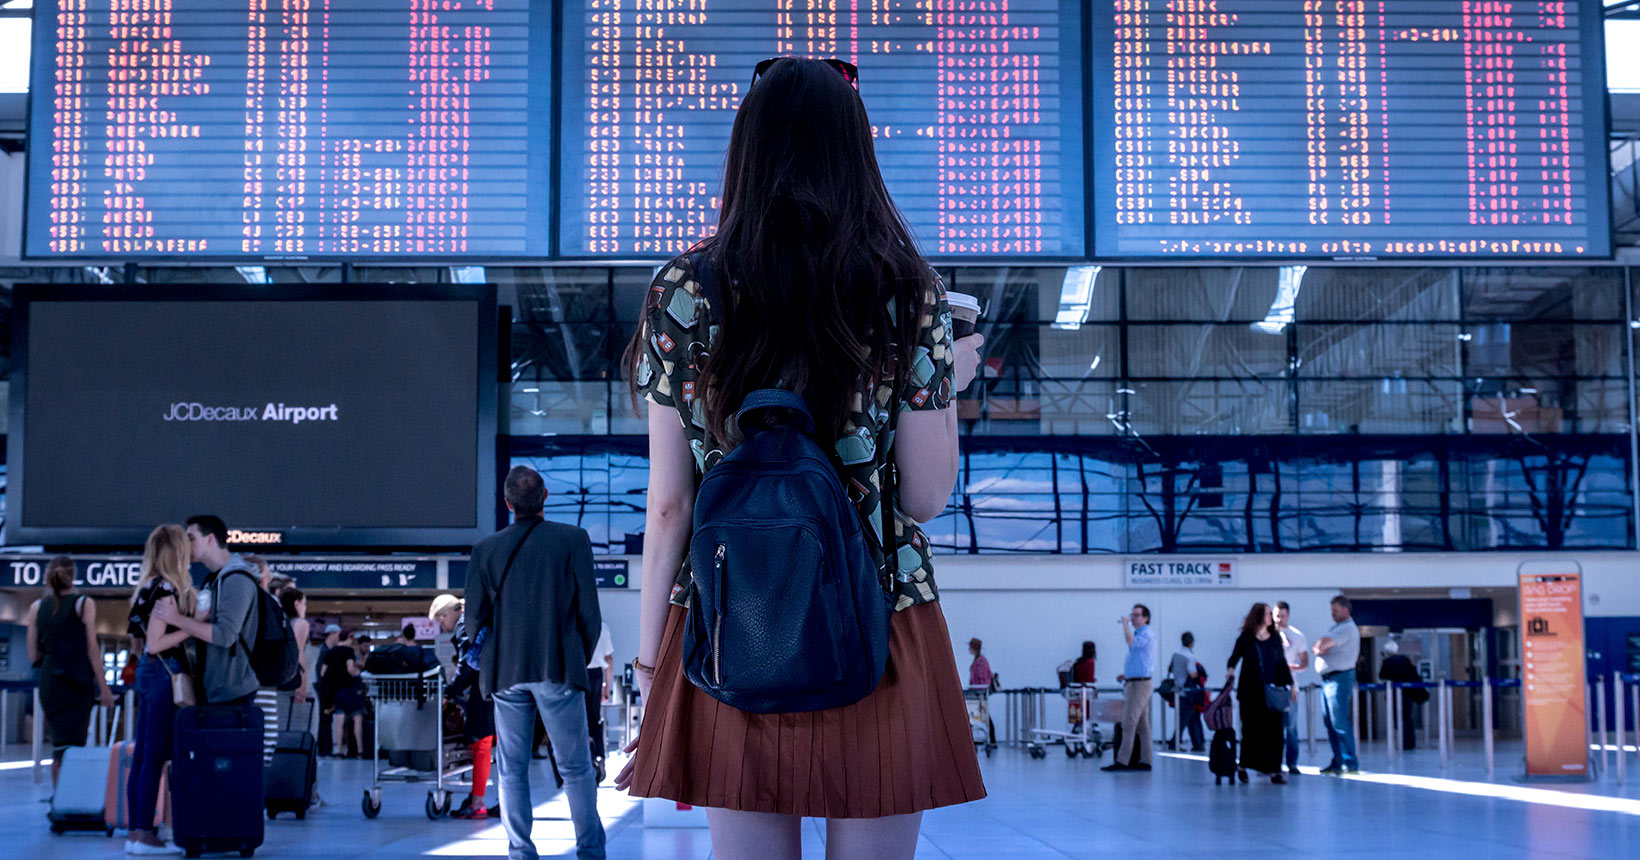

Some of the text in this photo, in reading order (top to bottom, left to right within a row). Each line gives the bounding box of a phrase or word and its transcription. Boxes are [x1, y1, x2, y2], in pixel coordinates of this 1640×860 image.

[163, 402, 338, 424] JCDecaux Airport
[10, 562, 40, 585] TO
[276, 563, 294, 571] YOUR
[294, 563, 328, 572] PASSPORT
[328, 563, 342, 571] AND
[343, 563, 376, 571] BOARDING
[377, 563, 393, 571] PASS
[394, 563, 416, 571] READY
[1131, 563, 1163, 575] FAST
[1168, 563, 1212, 575] TRACK
